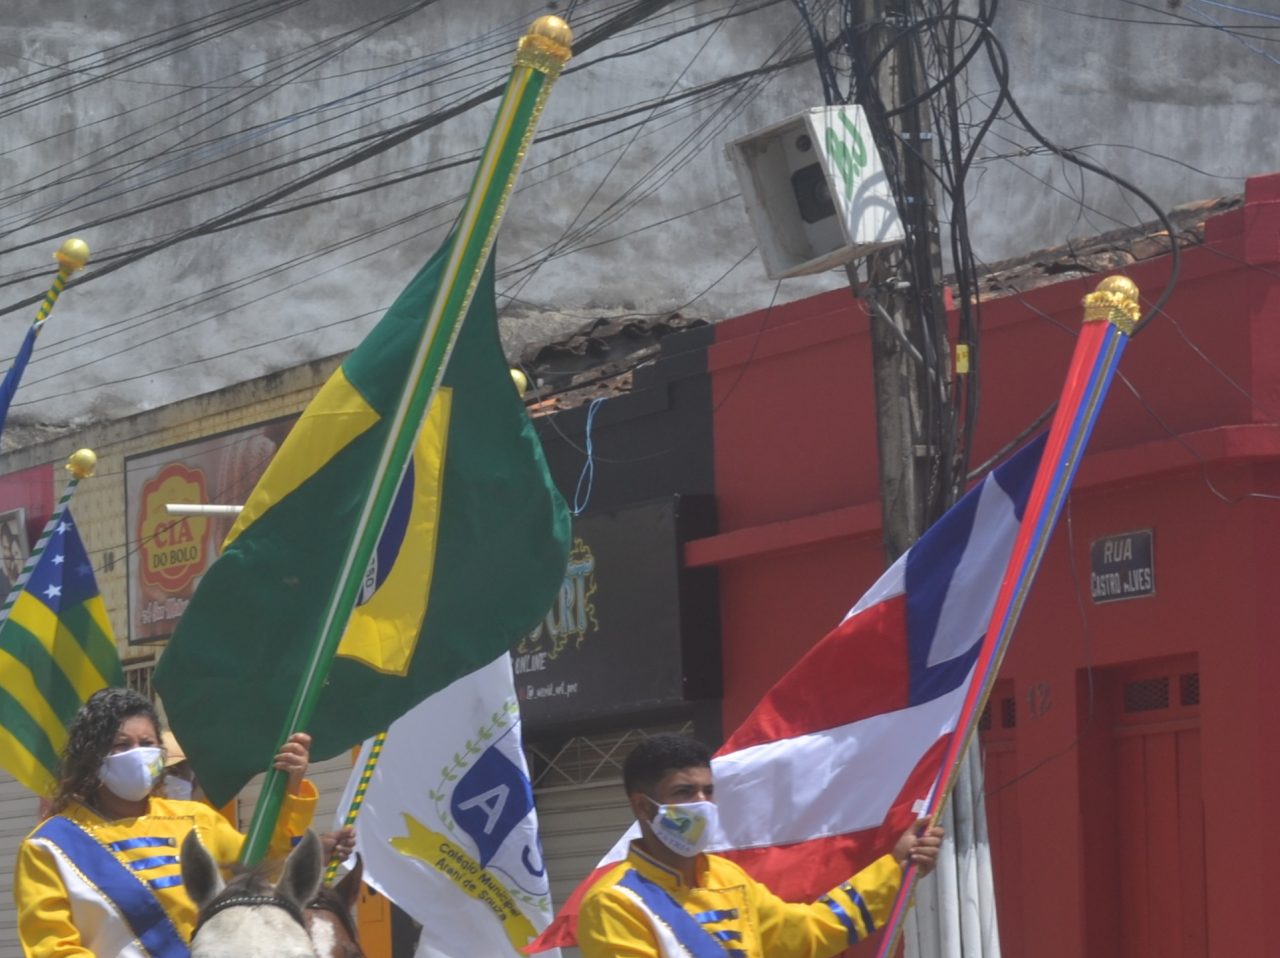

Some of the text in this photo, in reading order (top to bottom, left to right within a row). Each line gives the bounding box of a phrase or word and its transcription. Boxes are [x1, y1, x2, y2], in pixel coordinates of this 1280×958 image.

[154, 519, 194, 549] CIA
[153, 545, 198, 568] DO BOLO
[1104, 538, 1133, 564] RUA
[1091, 572, 1121, 598] CASTRO
[438, 843, 478, 875] Colégio
[463, 879, 477, 891] de
